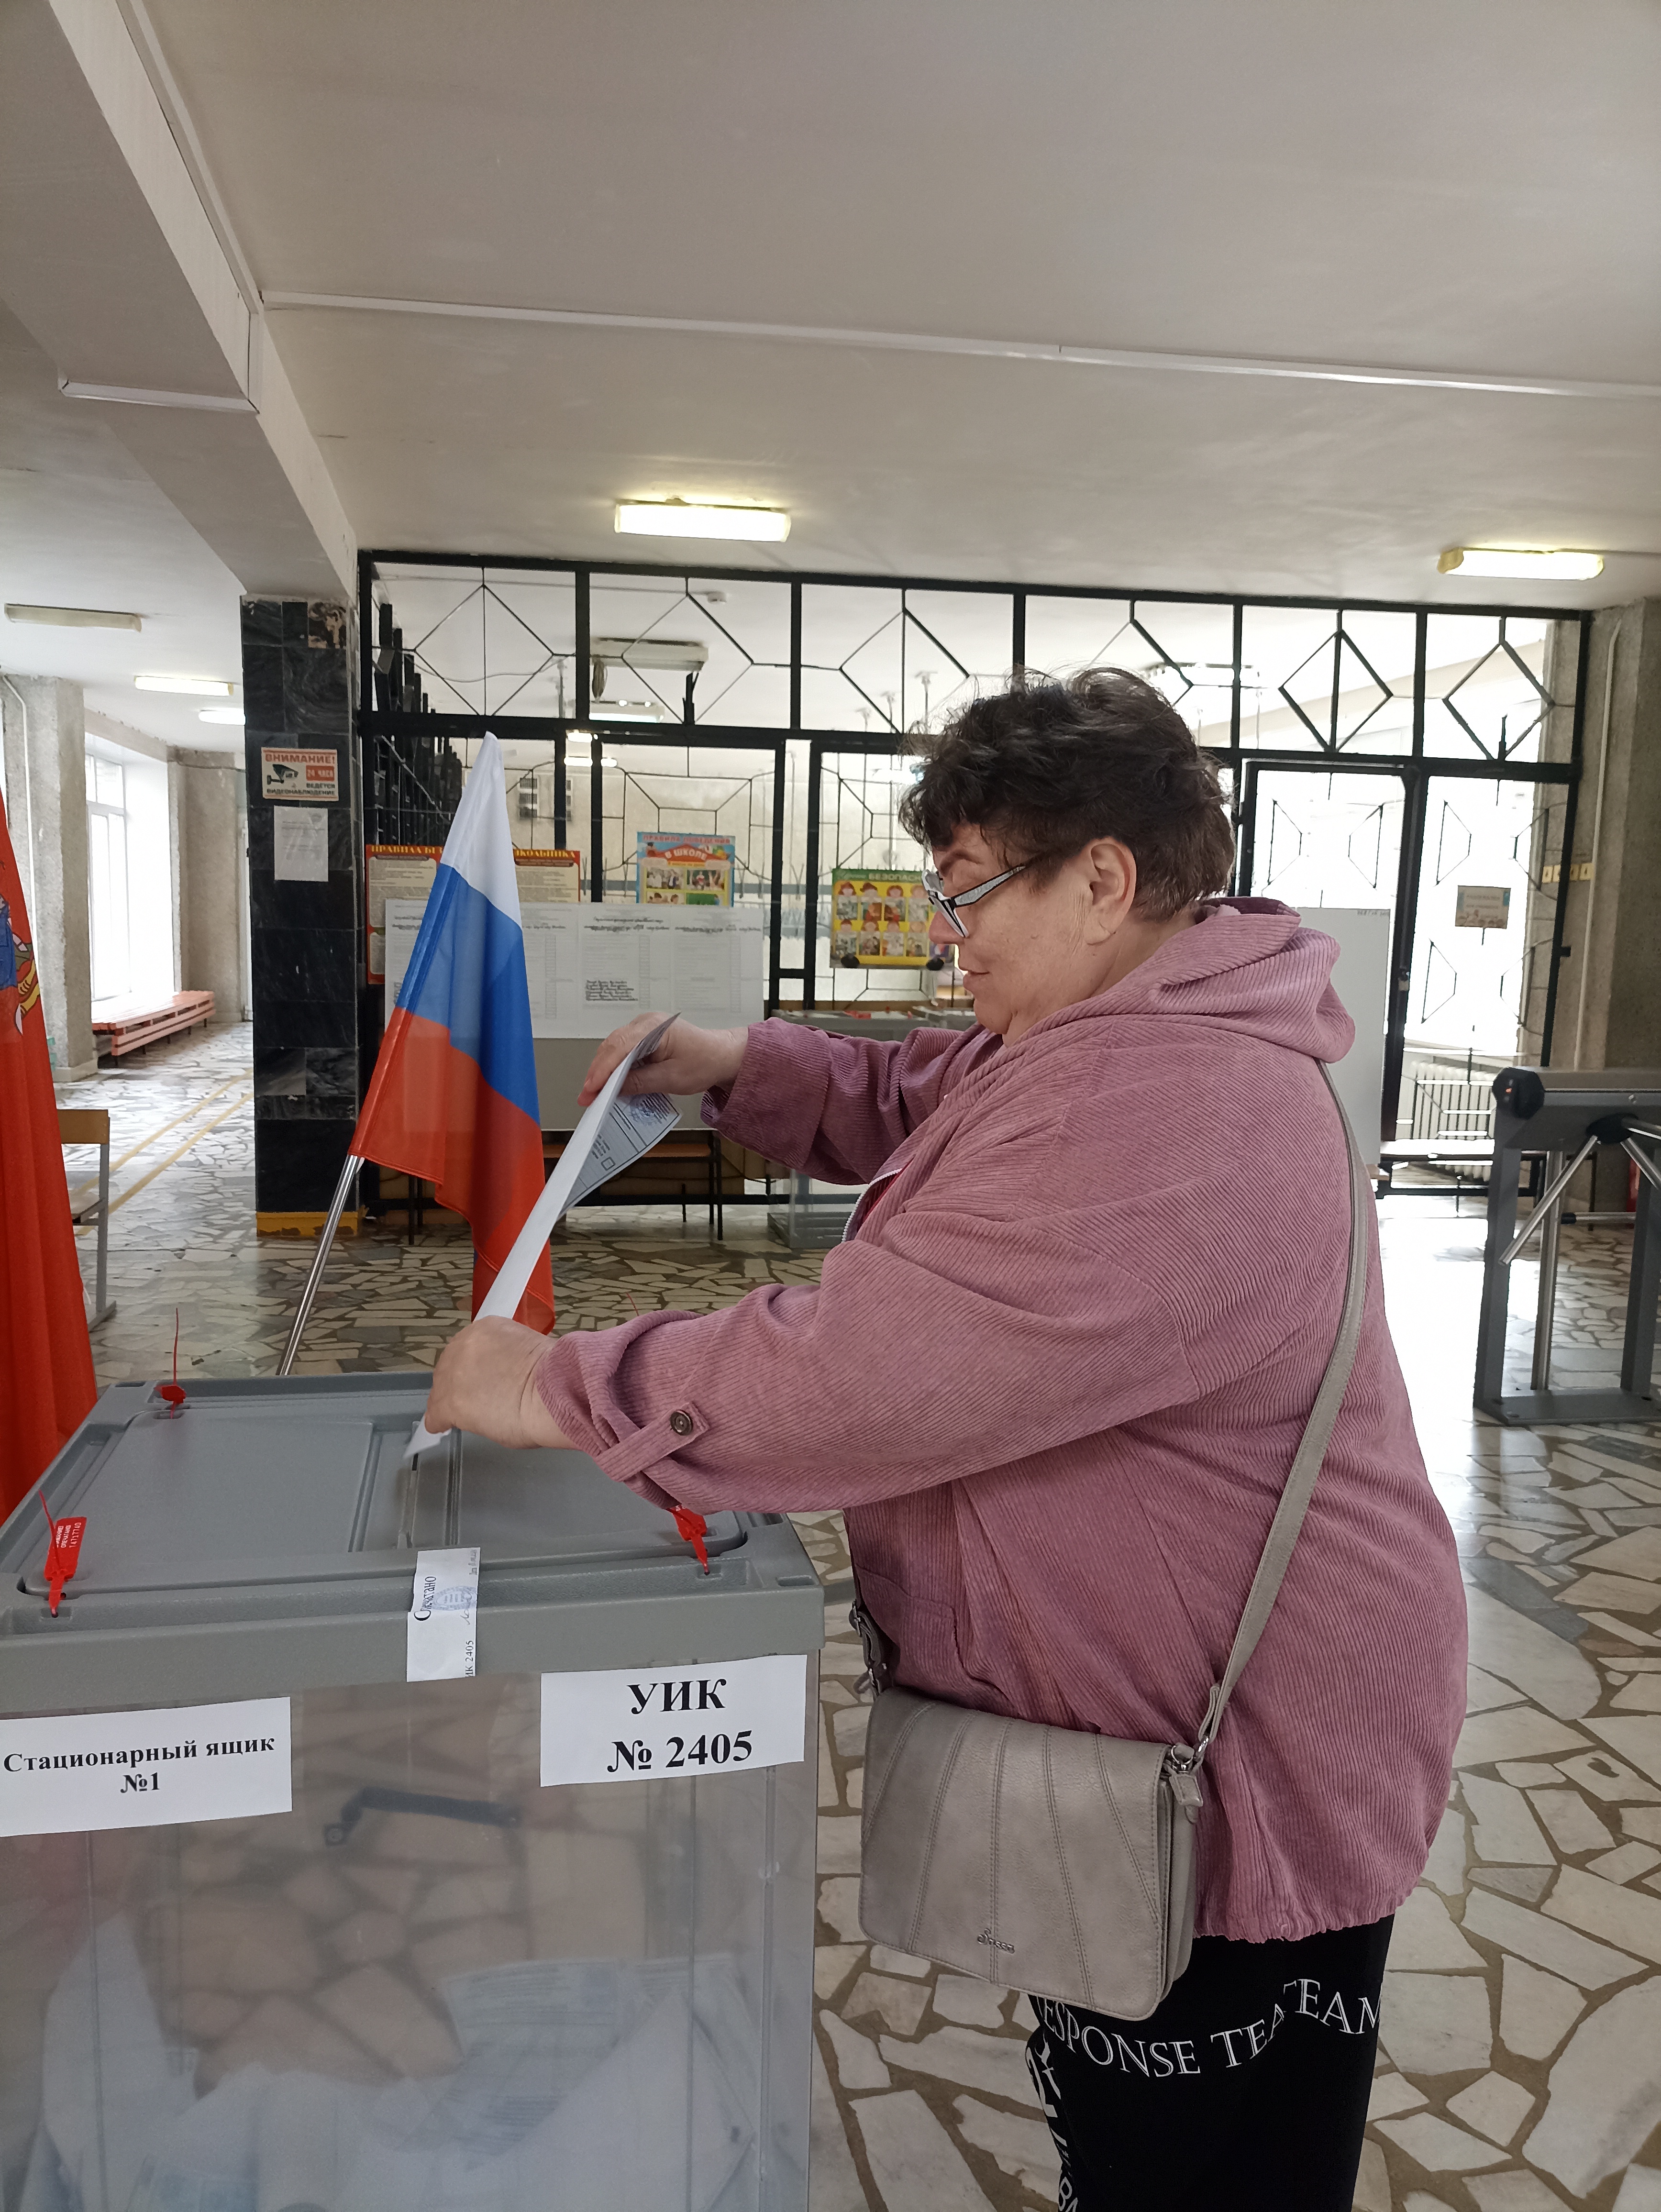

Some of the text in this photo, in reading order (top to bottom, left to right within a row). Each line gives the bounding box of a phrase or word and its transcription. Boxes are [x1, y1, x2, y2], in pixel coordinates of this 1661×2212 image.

[265, 754, 335, 764] ВНИМАНИЕ!
[371, 845, 421, 853] ПРАВИЛА
[674, 848, 708, 861] ШКОЛЕ
[868, 873, 922, 882] БЕЗОПАСН
[465, 1640, 474, 1677] ИК 2405
[627, 1678, 727, 1714] УИК
[3, 1737, 275, 1772] Стационарный ящик
[607, 1730, 752, 1773] № 2405
[120, 1772, 160, 1793] №1
[1036, 1996, 1201, 2077] ESPONSE
[1210, 2003, 1287, 2068] TEA
